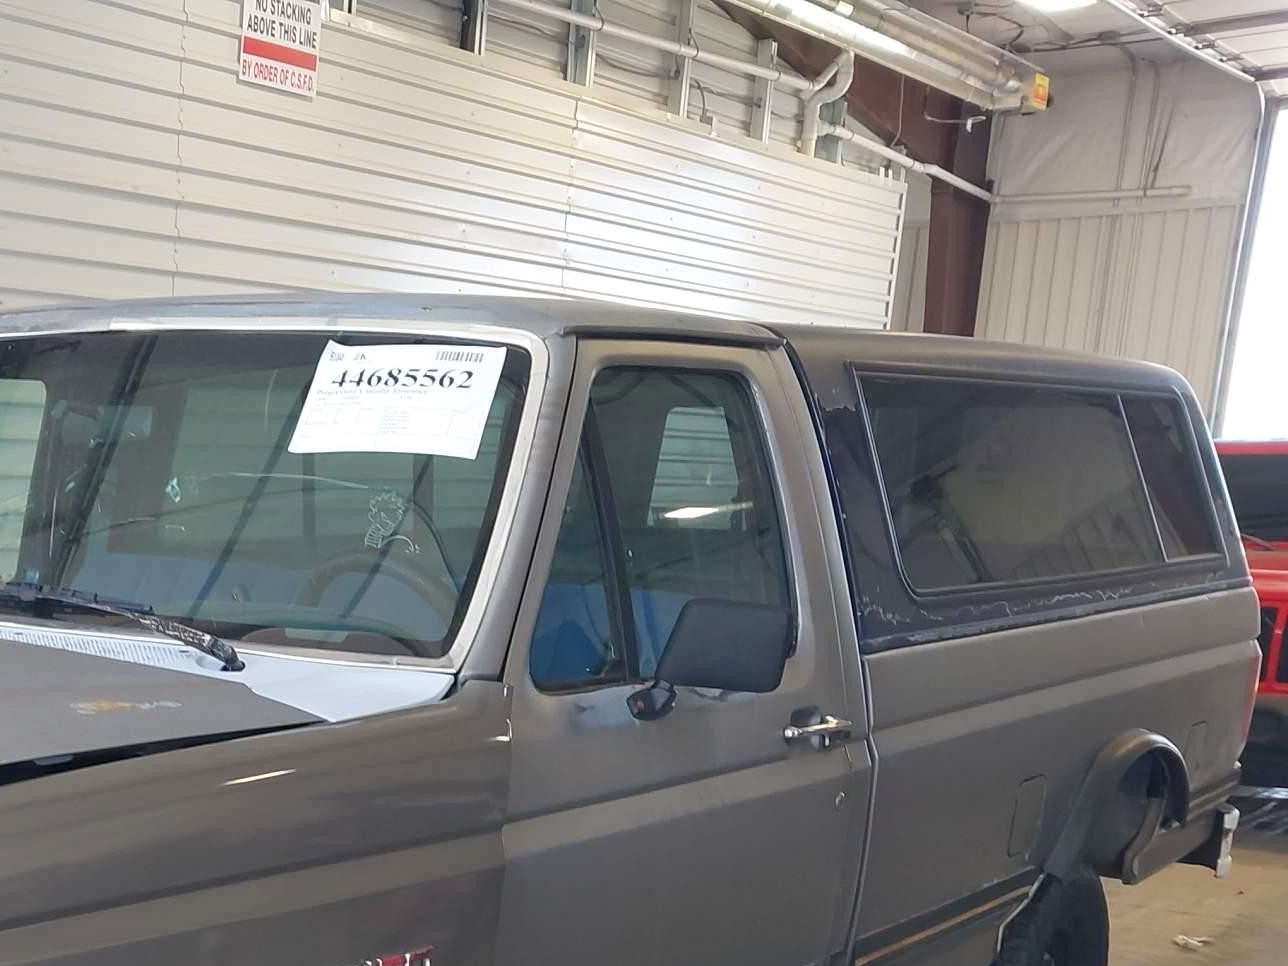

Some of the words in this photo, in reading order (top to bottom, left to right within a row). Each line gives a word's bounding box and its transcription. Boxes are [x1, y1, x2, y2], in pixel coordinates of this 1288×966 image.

[255, 0, 268, 12] NO
[270, 0, 312, 25] STACKING
[247, 14, 276, 37] ABOVE
[278, 22, 297, 43] THIS
[299, 29, 318, 49] LINE
[241, 59, 252, 77] BY
[253, 62, 278, 82] ORDER
[279, 69, 290, 85] OF
[331, 368, 474, 388] 44685562
